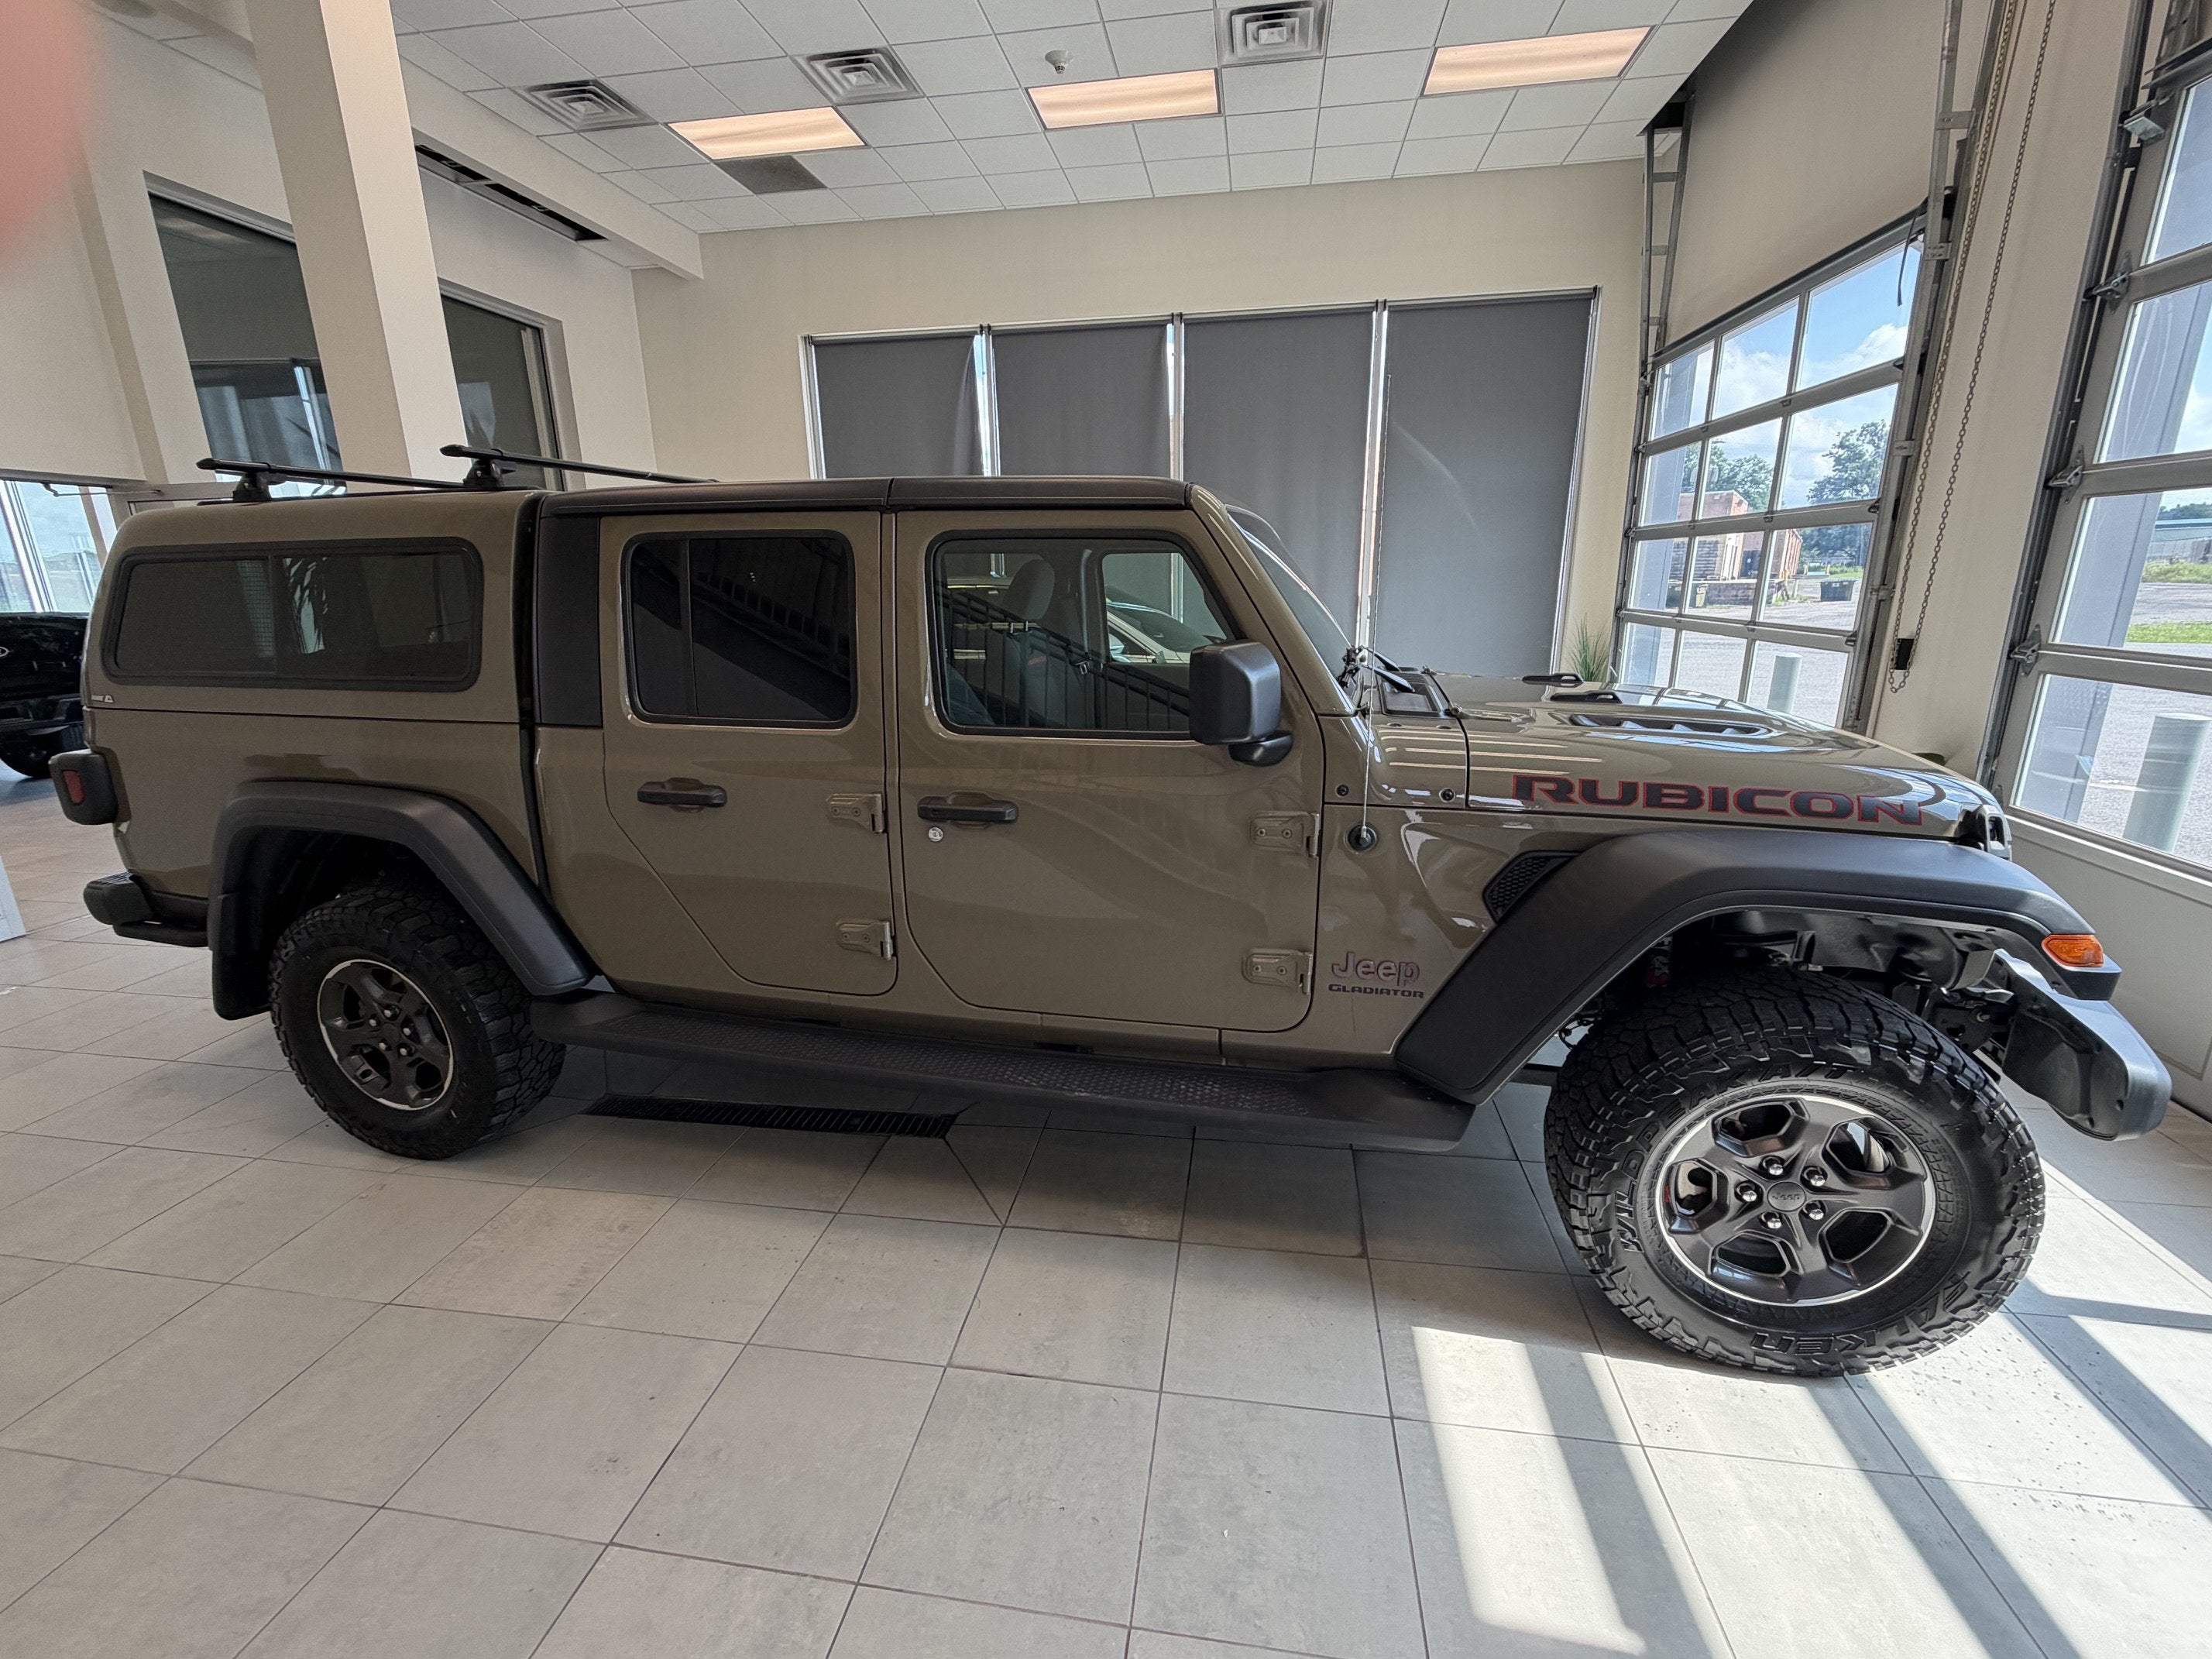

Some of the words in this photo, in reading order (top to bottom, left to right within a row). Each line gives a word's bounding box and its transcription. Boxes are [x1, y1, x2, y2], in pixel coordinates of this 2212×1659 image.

[1513, 774, 1924, 826] RUBICON
[1331, 951, 1420, 988] Jeep
[1328, 984, 1424, 999] GLADIATOR
